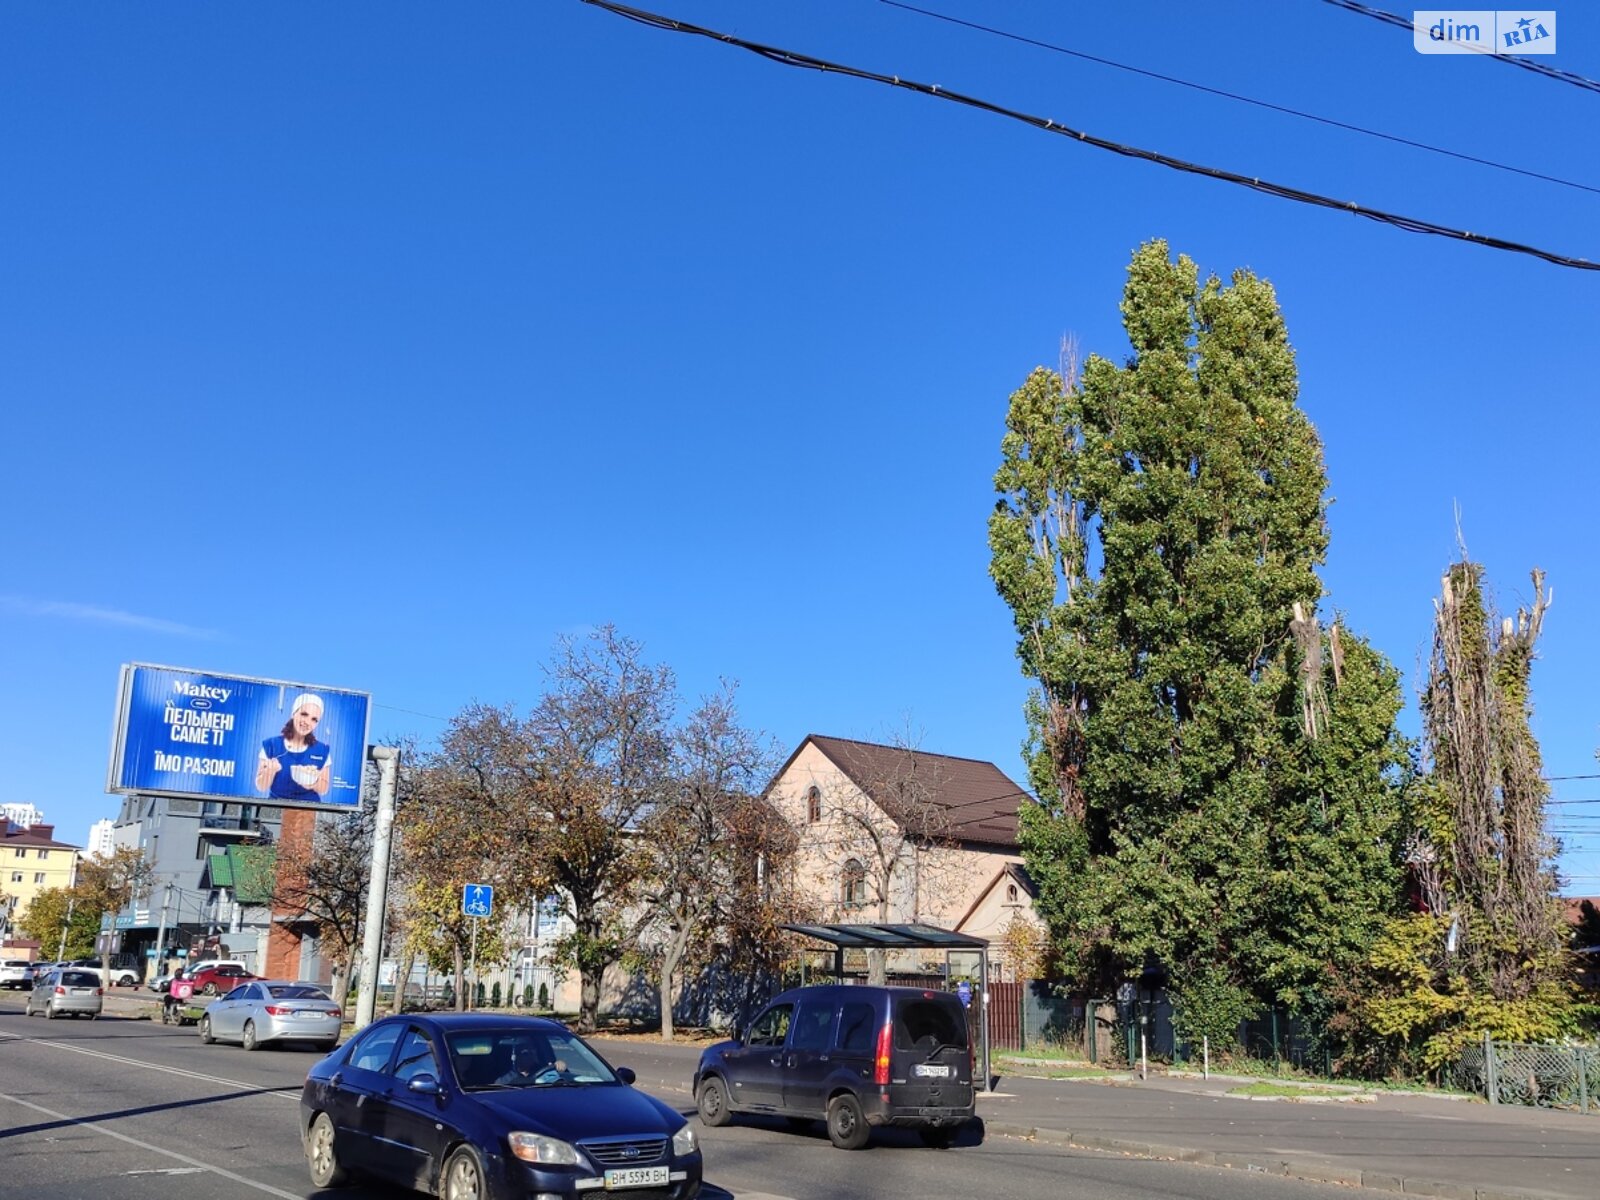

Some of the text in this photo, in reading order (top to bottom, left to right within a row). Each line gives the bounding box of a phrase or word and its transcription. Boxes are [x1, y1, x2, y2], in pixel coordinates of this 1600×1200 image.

[173, 680, 232, 703] Makey
[164, 707, 234, 731] ПЕЛЬМЕНІ
[170, 725, 224, 746] САМЕ ТІ
[154, 750, 235, 777] ЇМО РАЗОМ!
[653, 1169, 667, 1182] BH
